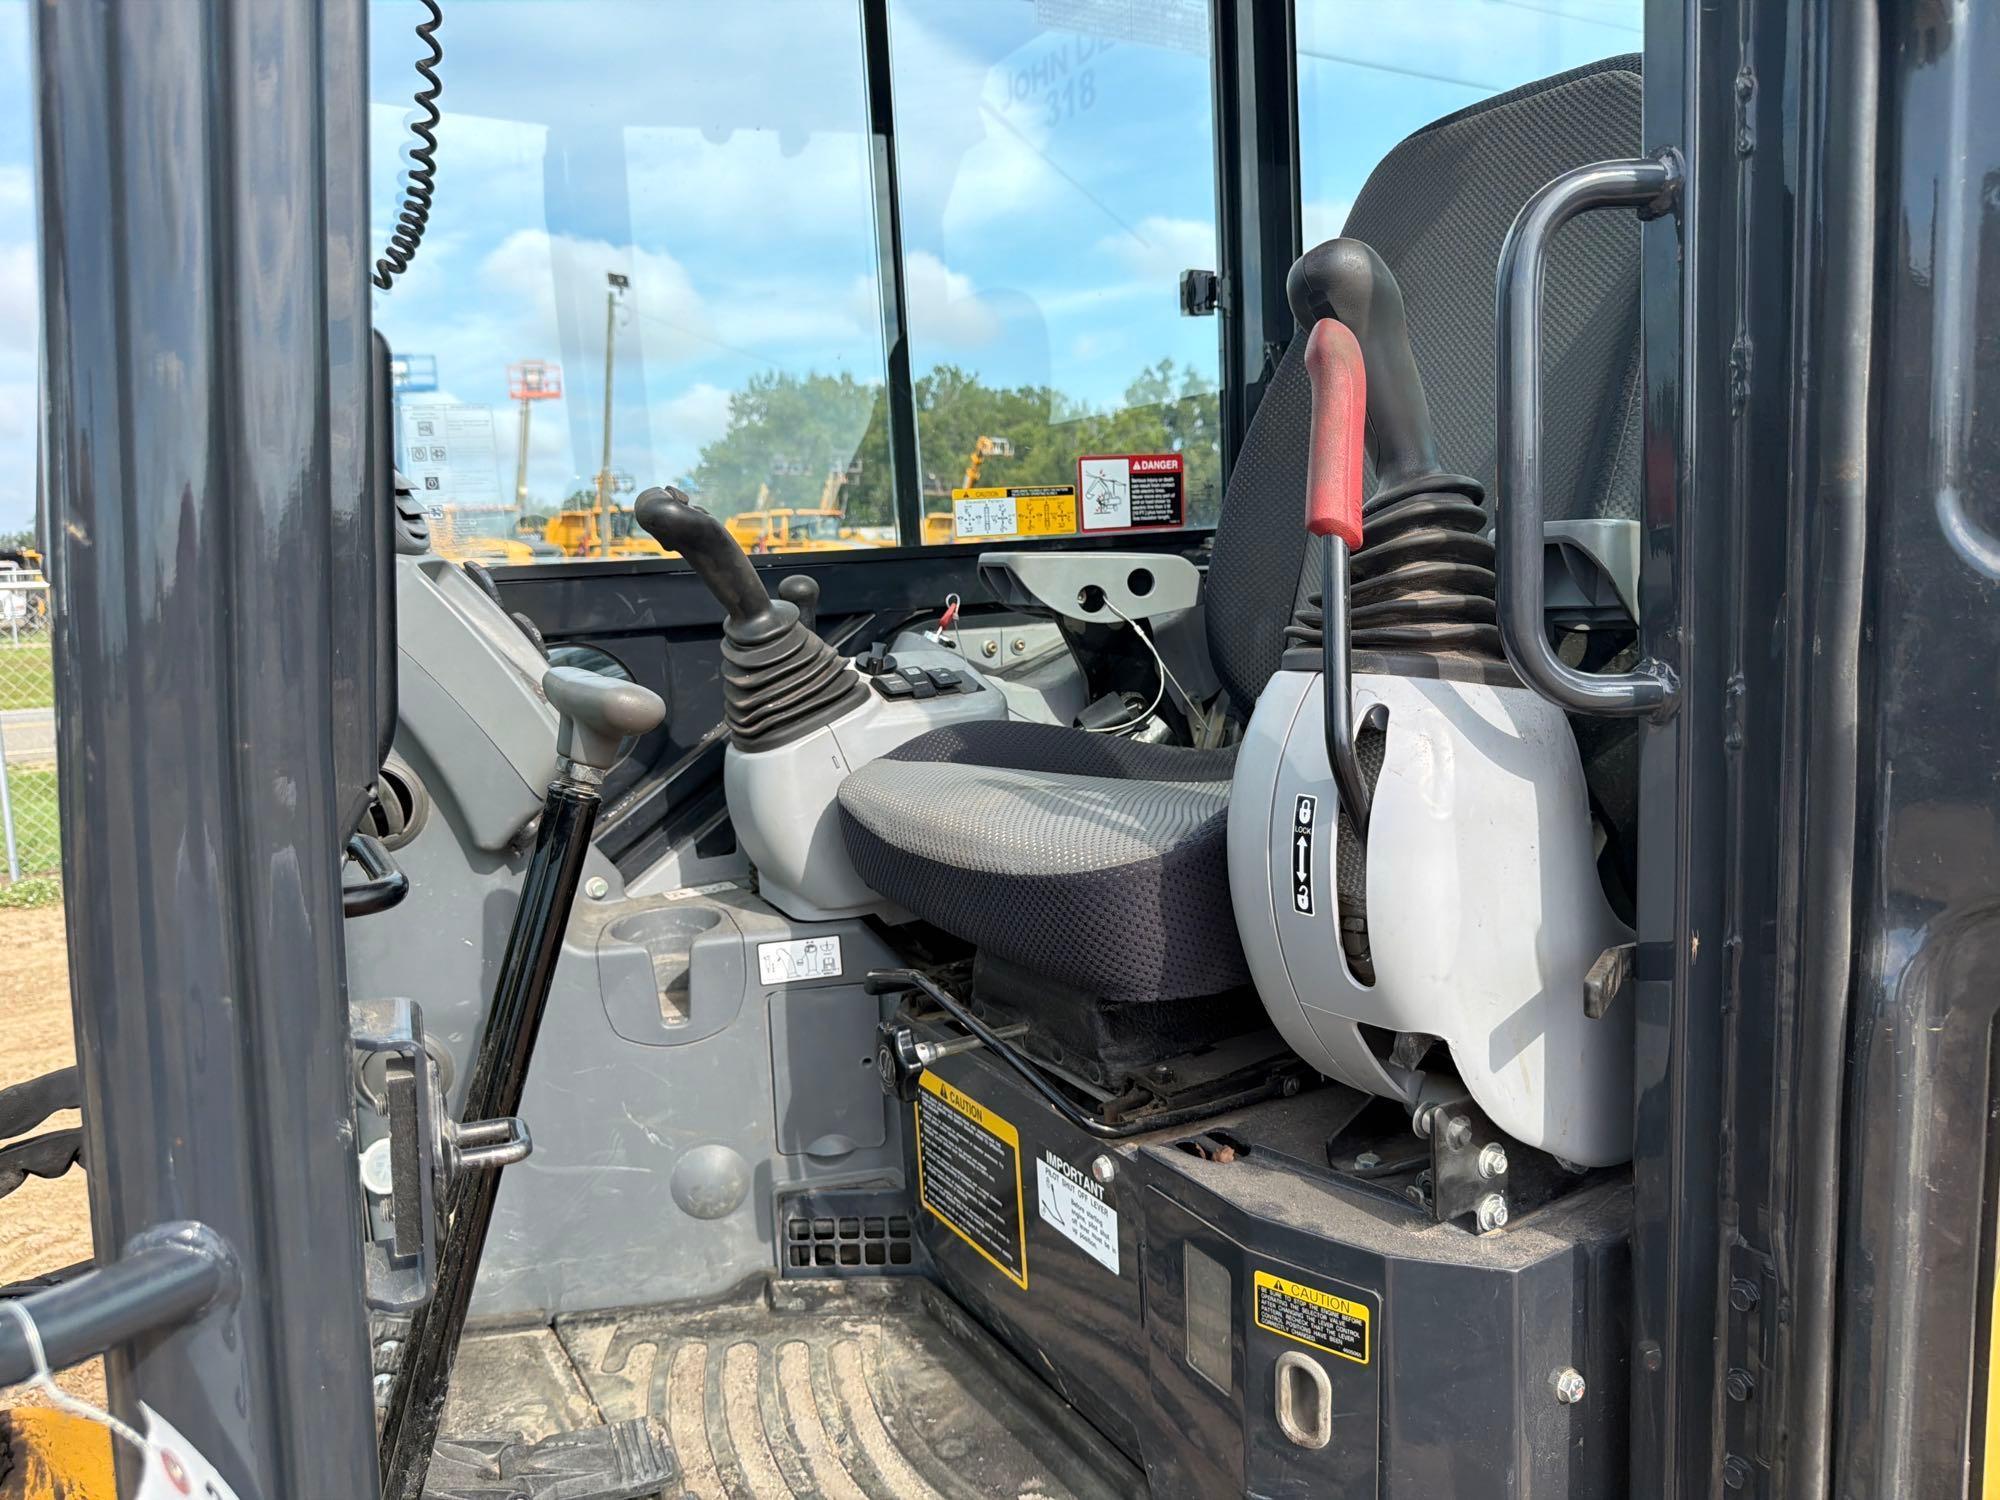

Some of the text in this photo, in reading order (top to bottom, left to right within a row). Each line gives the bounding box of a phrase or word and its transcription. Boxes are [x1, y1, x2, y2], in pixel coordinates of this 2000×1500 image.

[1002, 44, 1068, 111] JOHN
[1045, 68, 1096, 128] 318
[1142, 460, 1178, 470] DANGER
[1295, 826, 1311, 835] LOCK
[950, 1092, 982, 1122] CAUTION
[1046, 1150, 1104, 1200] IMPORTANT
[1045, 1167, 1108, 1216] PILOT SHUT OFF LEVER
[1071, 1198, 1103, 1228] Before starting
[1079, 1223, 1089, 1234] lever
[1092, 1232, 1102, 1245] must
[1261, 1293, 1287, 1307] OPERATING
[1302, 1307, 1327, 1321] SELECTOR
[1270, 1290, 1282, 1299] SURE
[1294, 1297, 1306, 1306] STOP
[1309, 1303, 1319, 1311] THE
[1321, 1307, 1339, 1319] ENGINE
[1342, 1313, 1362, 1326] BEFORE
[1291, 1285, 1350, 1313] CAUTION
[1261, 1300, 1360, 1339] AFTER CHANGING THE LEVER CONTROL
[1261, 1318, 1289, 1332] CORRECTLY
[1261, 1312, 1343, 1345] CONTROL POSITIONS HAVE BEEN
[1285, 1314, 1308, 1326] RECHECK
[1311, 1323, 1324, 1332] THAT
[1338, 1333, 1354, 1343] LEVER
